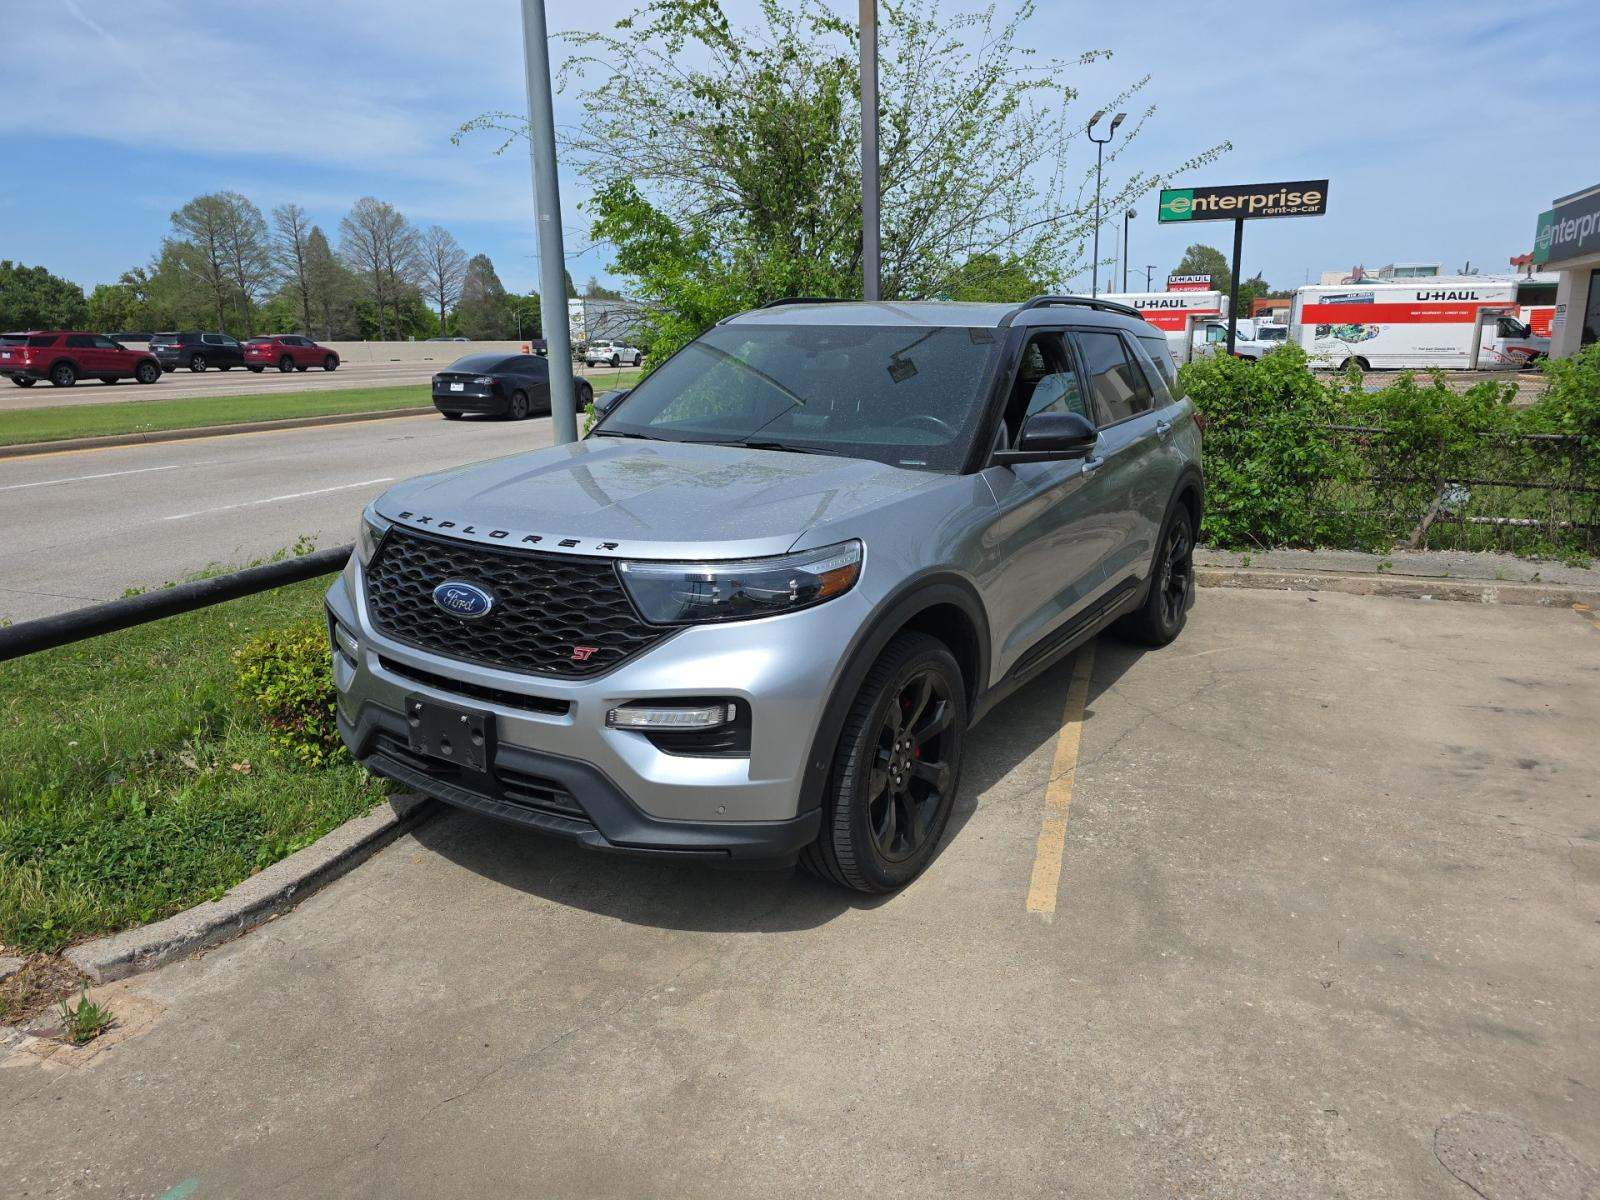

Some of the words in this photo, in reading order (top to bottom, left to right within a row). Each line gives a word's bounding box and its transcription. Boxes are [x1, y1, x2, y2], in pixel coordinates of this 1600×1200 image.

[1161, 188, 1322, 213] enterprise
[1263, 204, 1320, 215] rent-a-car
[1170, 275, 1210, 283] U-HAUL
[1416, 291, 1479, 301] U-HAUL
[1134, 299, 1188, 309] U-HAUL
[398, 511, 619, 551] EXPLORER
[443, 588, 476, 612] Ford
[571, 646, 599, 661] ST
